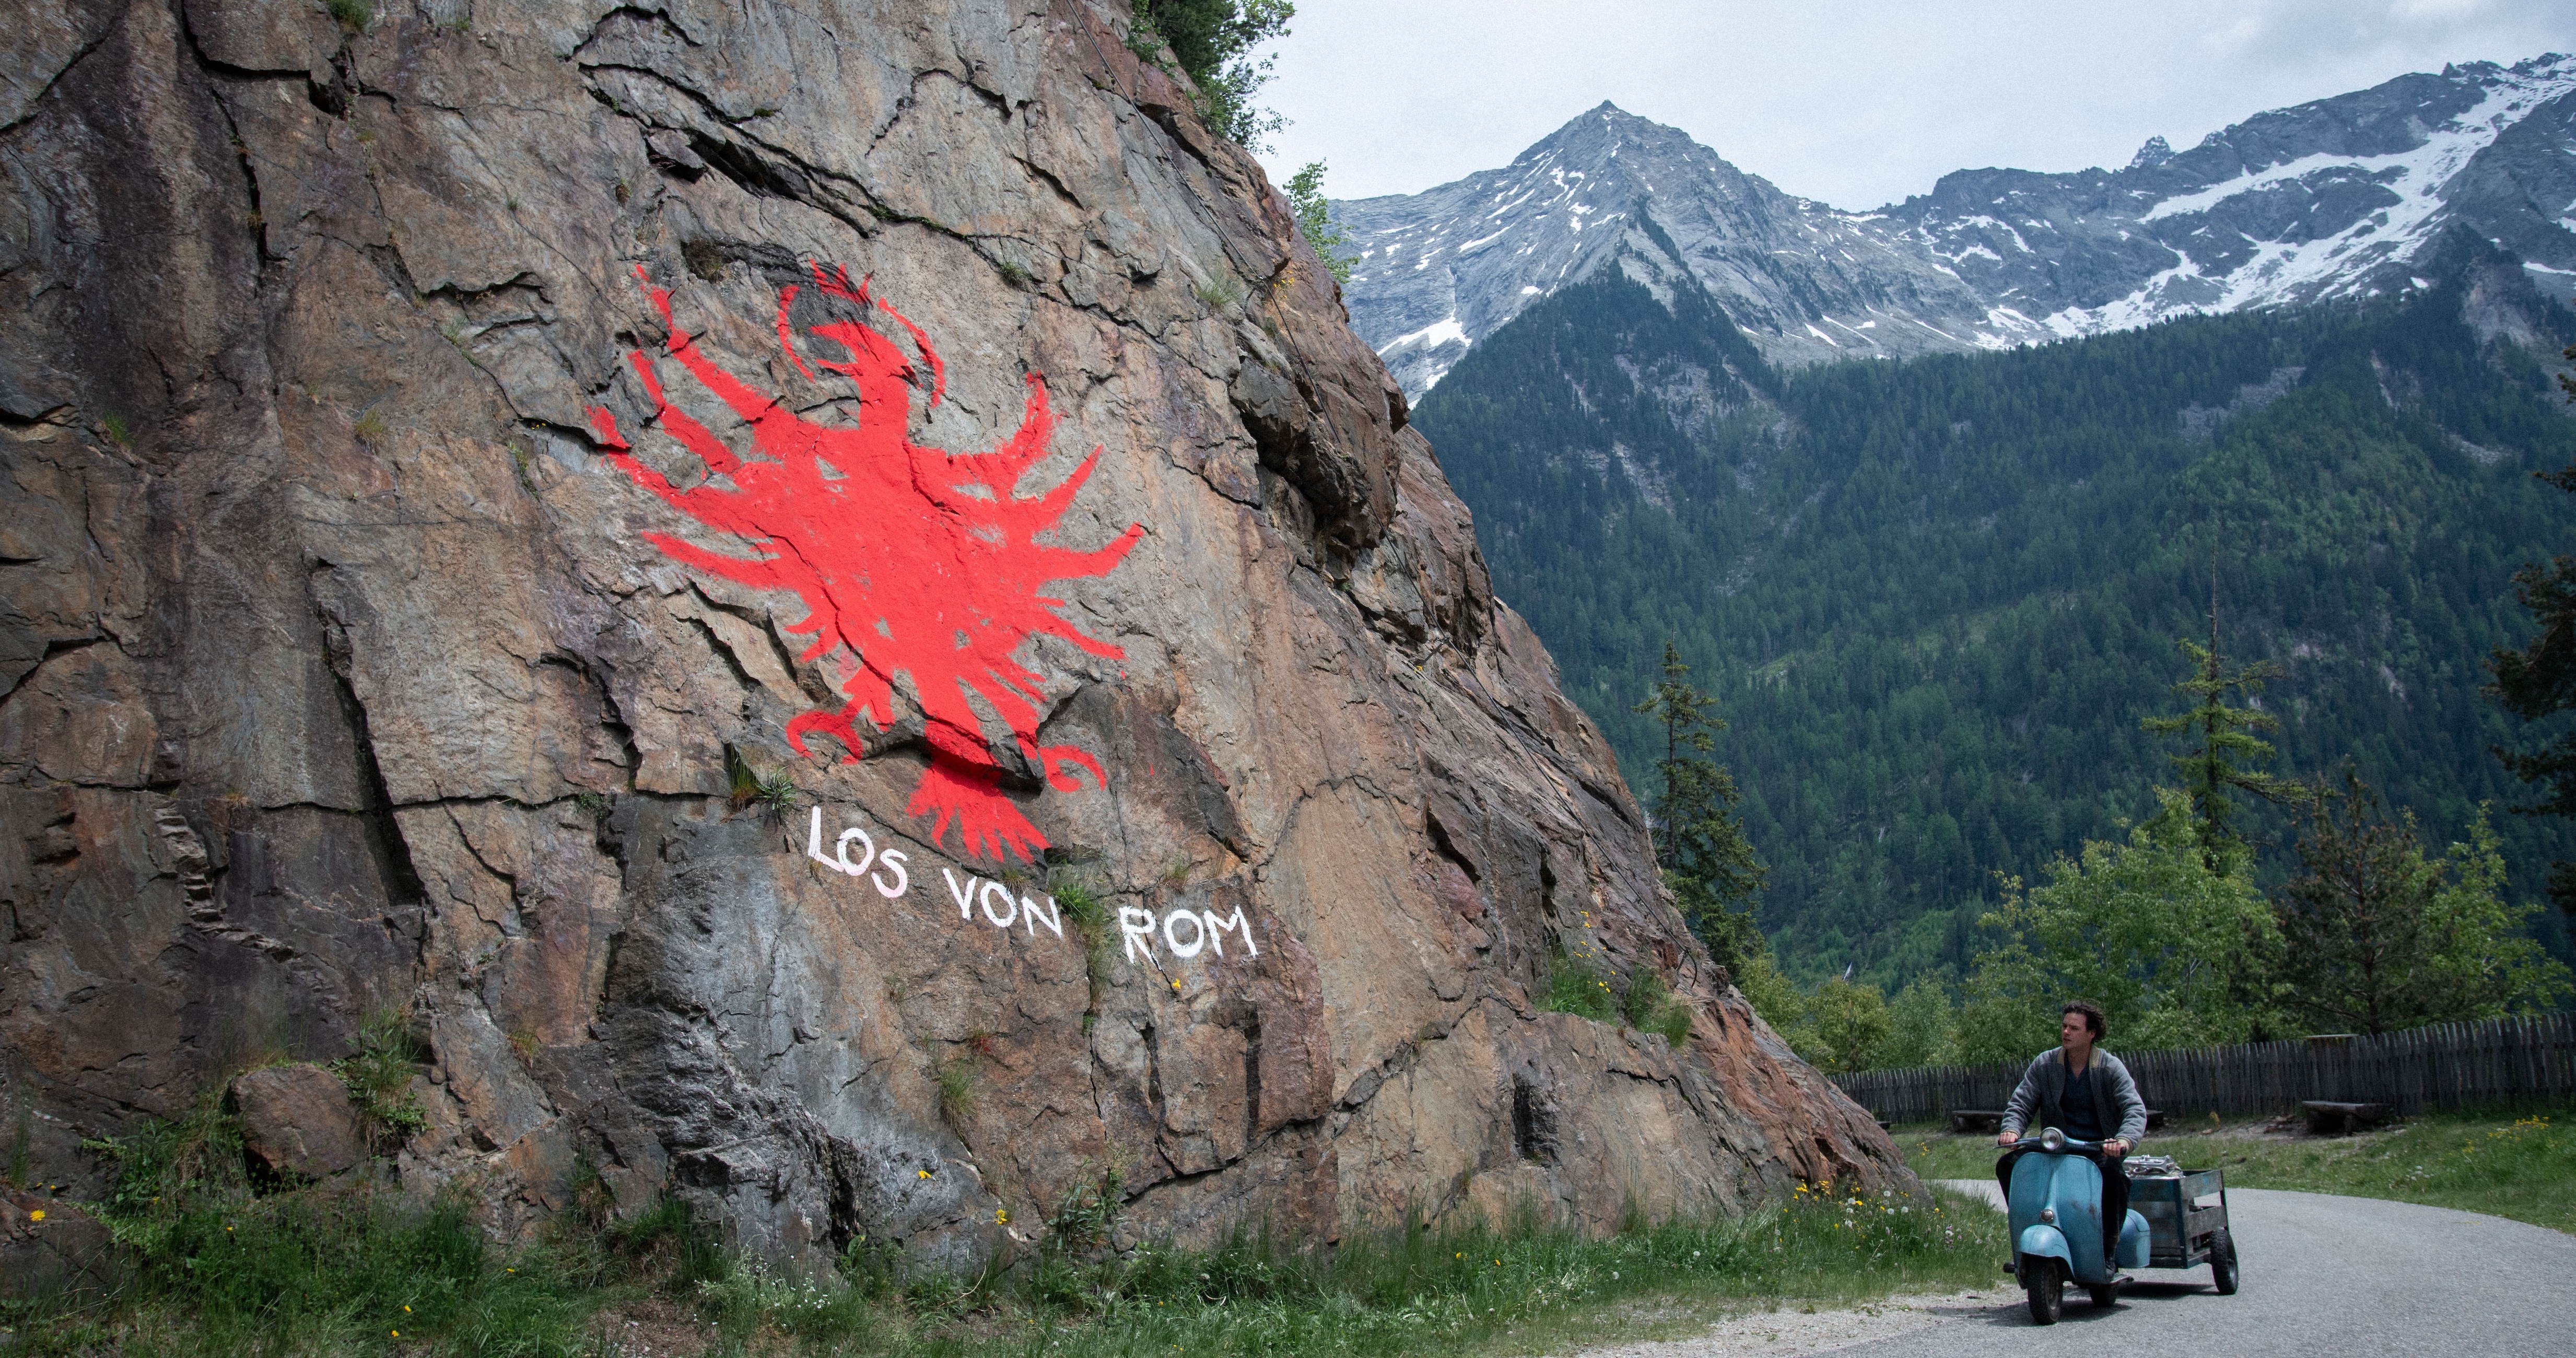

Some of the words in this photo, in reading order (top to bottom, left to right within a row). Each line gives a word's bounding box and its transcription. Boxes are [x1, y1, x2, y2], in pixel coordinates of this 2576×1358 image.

[807, 805, 909, 899] LOS
[942, 868, 1063, 939] VON
[1118, 905, 1259, 967] ROM
